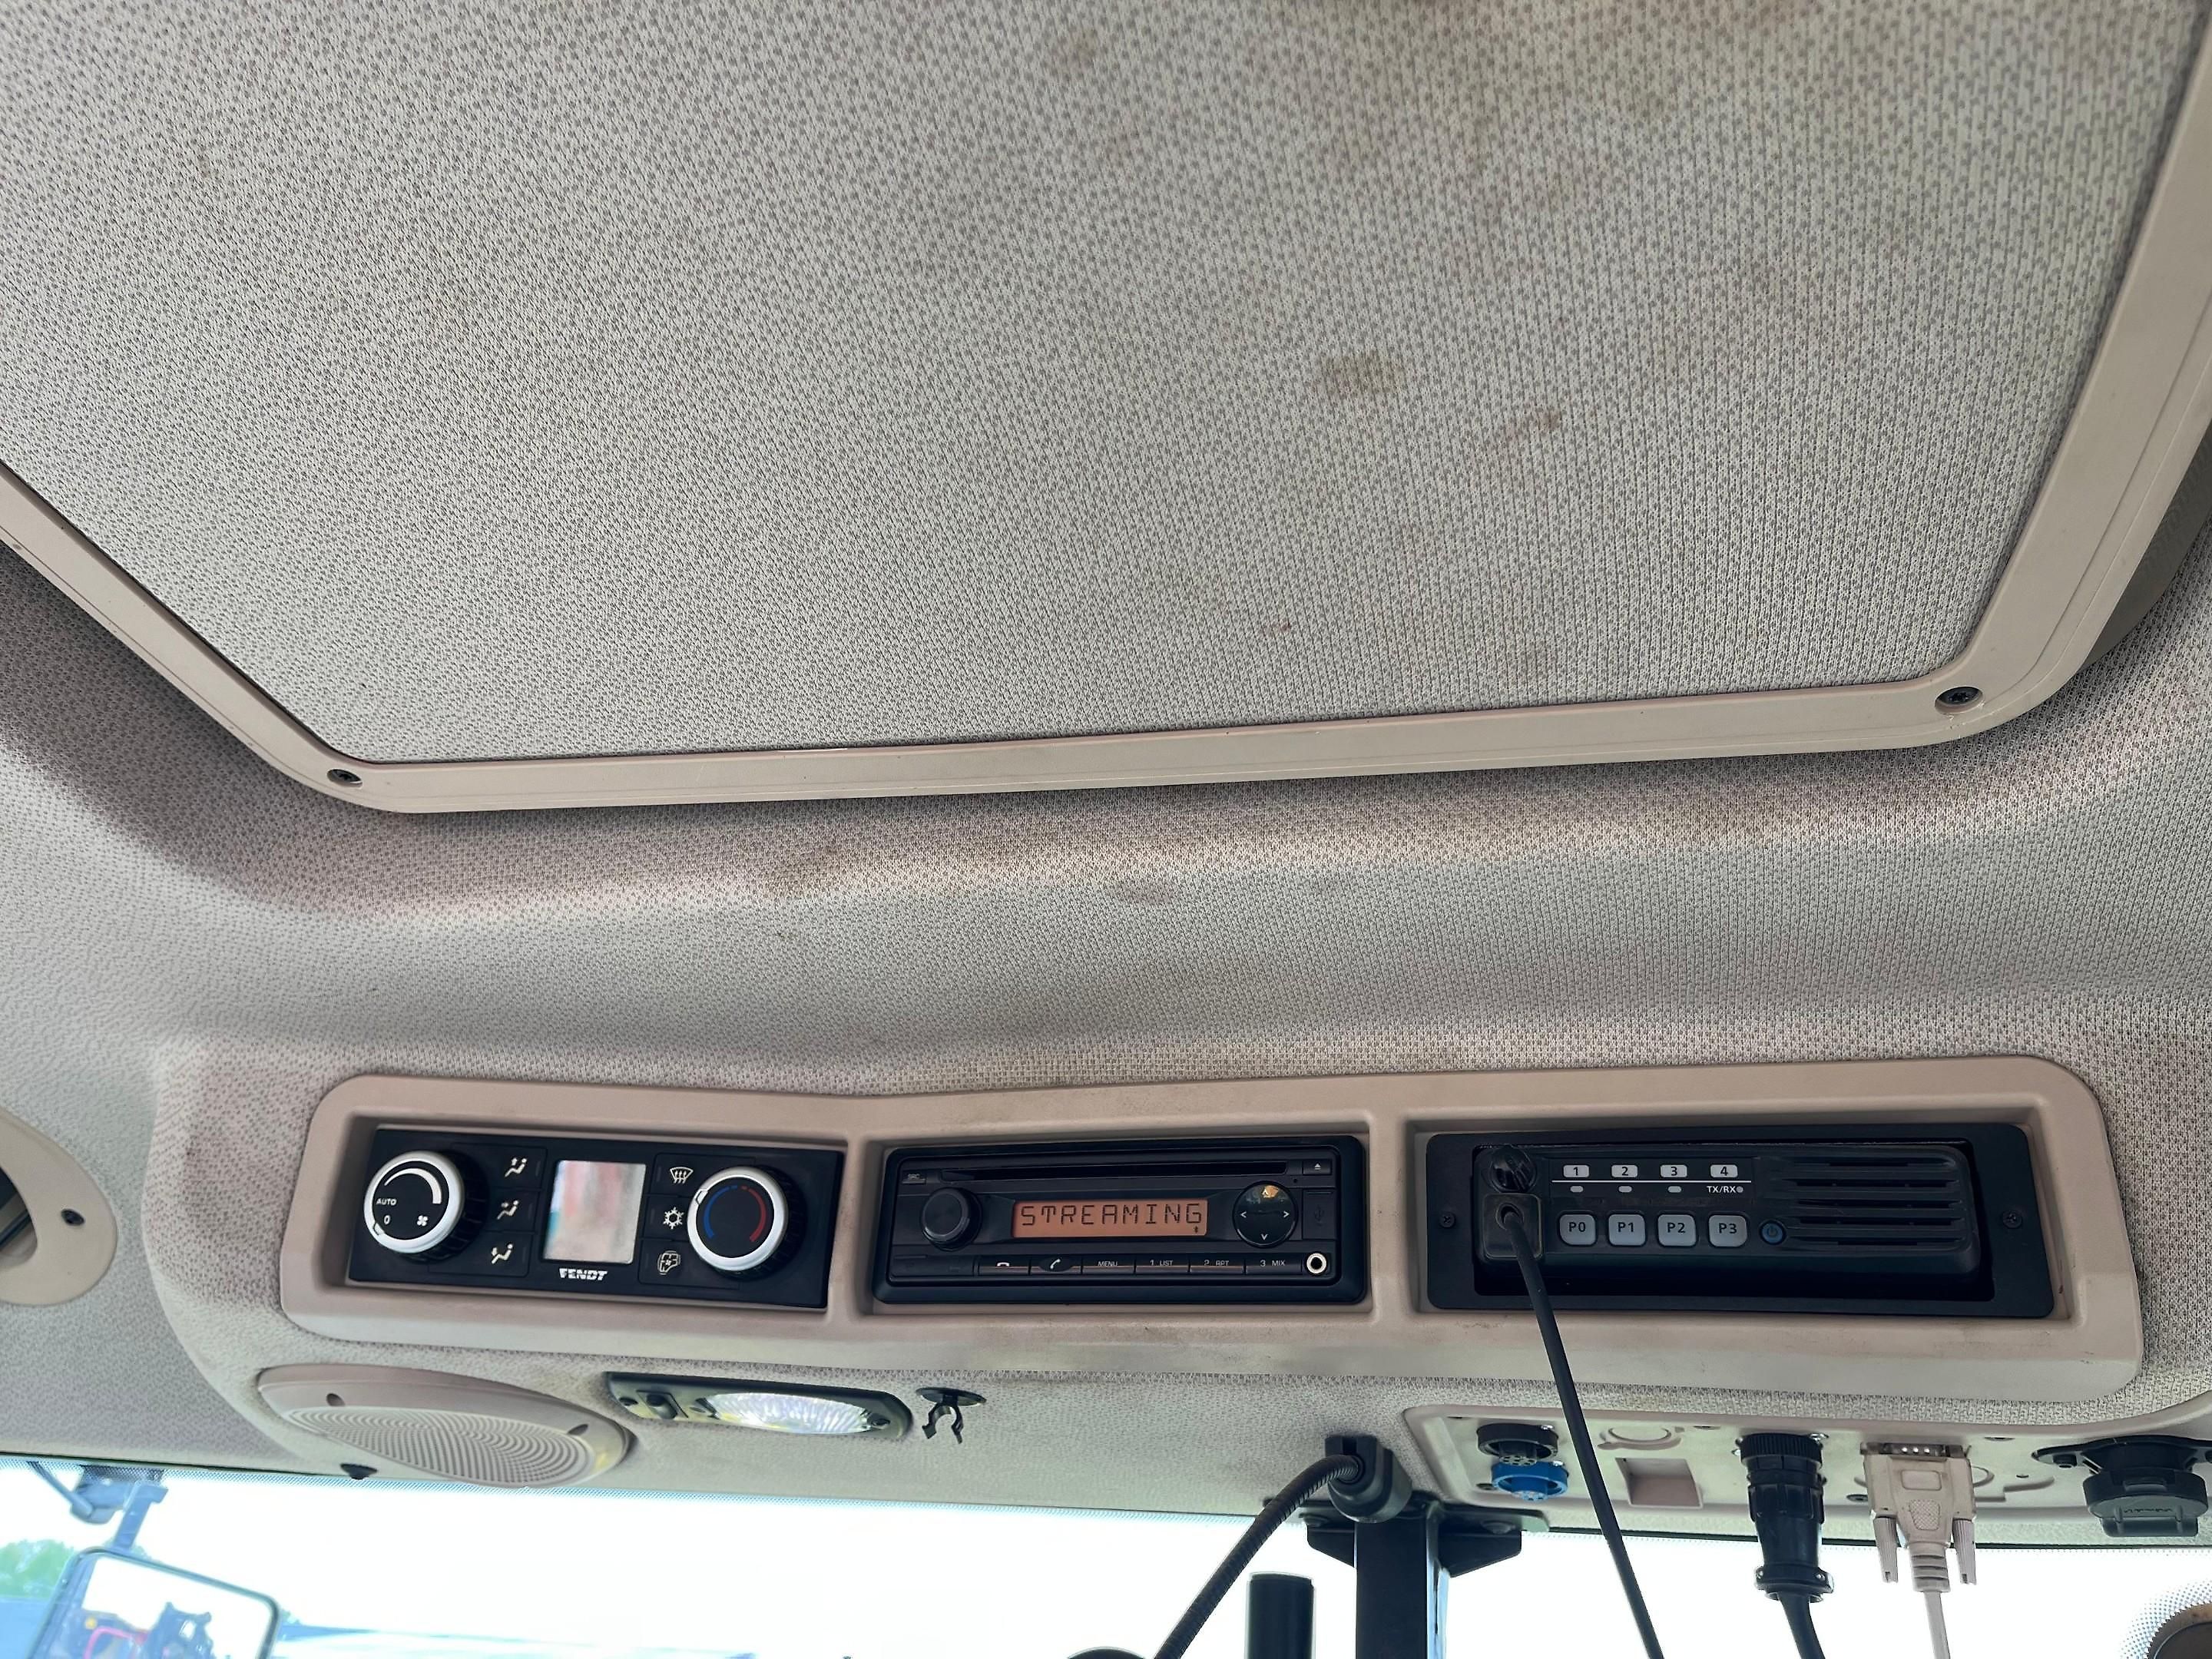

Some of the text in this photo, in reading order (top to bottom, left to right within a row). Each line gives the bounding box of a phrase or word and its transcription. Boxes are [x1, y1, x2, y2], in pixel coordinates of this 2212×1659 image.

[1572, 1167, 1579, 1176] 1
[1621, 1167, 1629, 1176] 2
[1671, 1167, 1677, 1176] 3
[1720, 1167, 1729, 1176] 4
[1707, 1185, 1736, 1194] TX/RX
[376, 1197, 398, 1207] AUTO
[1020, 1203, 1202, 1227] STREAMING
[1568, 1221, 1586, 1233] P0
[1618, 1222, 1634, 1233] P1
[1667, 1222, 1686, 1233] P2
[1718, 1223, 1737, 1234] P3
[1260, 1259, 1267, 1267] 3
[558, 1267, 608, 1281] FENDT
